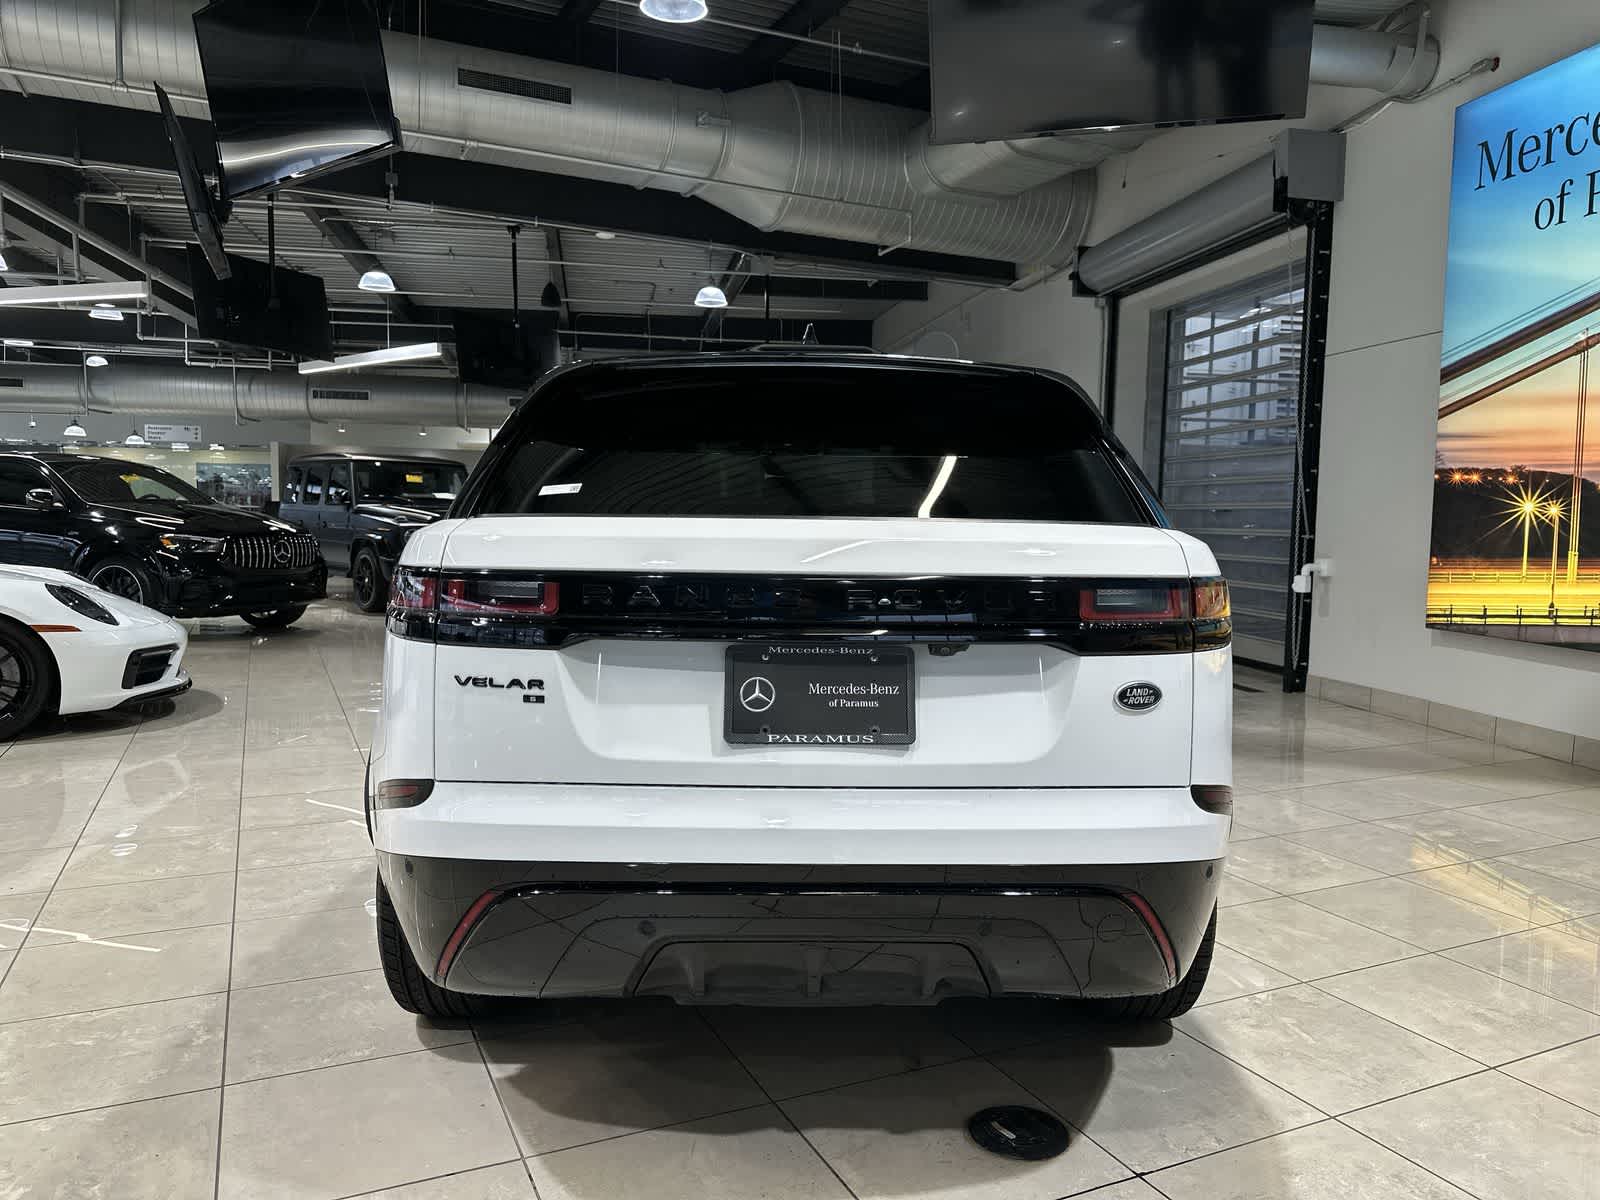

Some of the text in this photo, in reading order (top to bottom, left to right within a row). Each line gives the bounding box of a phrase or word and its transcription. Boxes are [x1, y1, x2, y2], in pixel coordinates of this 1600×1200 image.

[1534, 178, 1574, 230] of
[768, 646, 873, 654] Mercedes-Benz
[454, 675, 545, 690] VELAR
[808, 681, 900, 695] Mercedes-Benz
[1126, 688, 1149, 696] LAND
[828, 699, 879, 708] of Paramus
[1128, 695, 1155, 704] ROVER
[767, 734, 874, 744] PARAMUS
